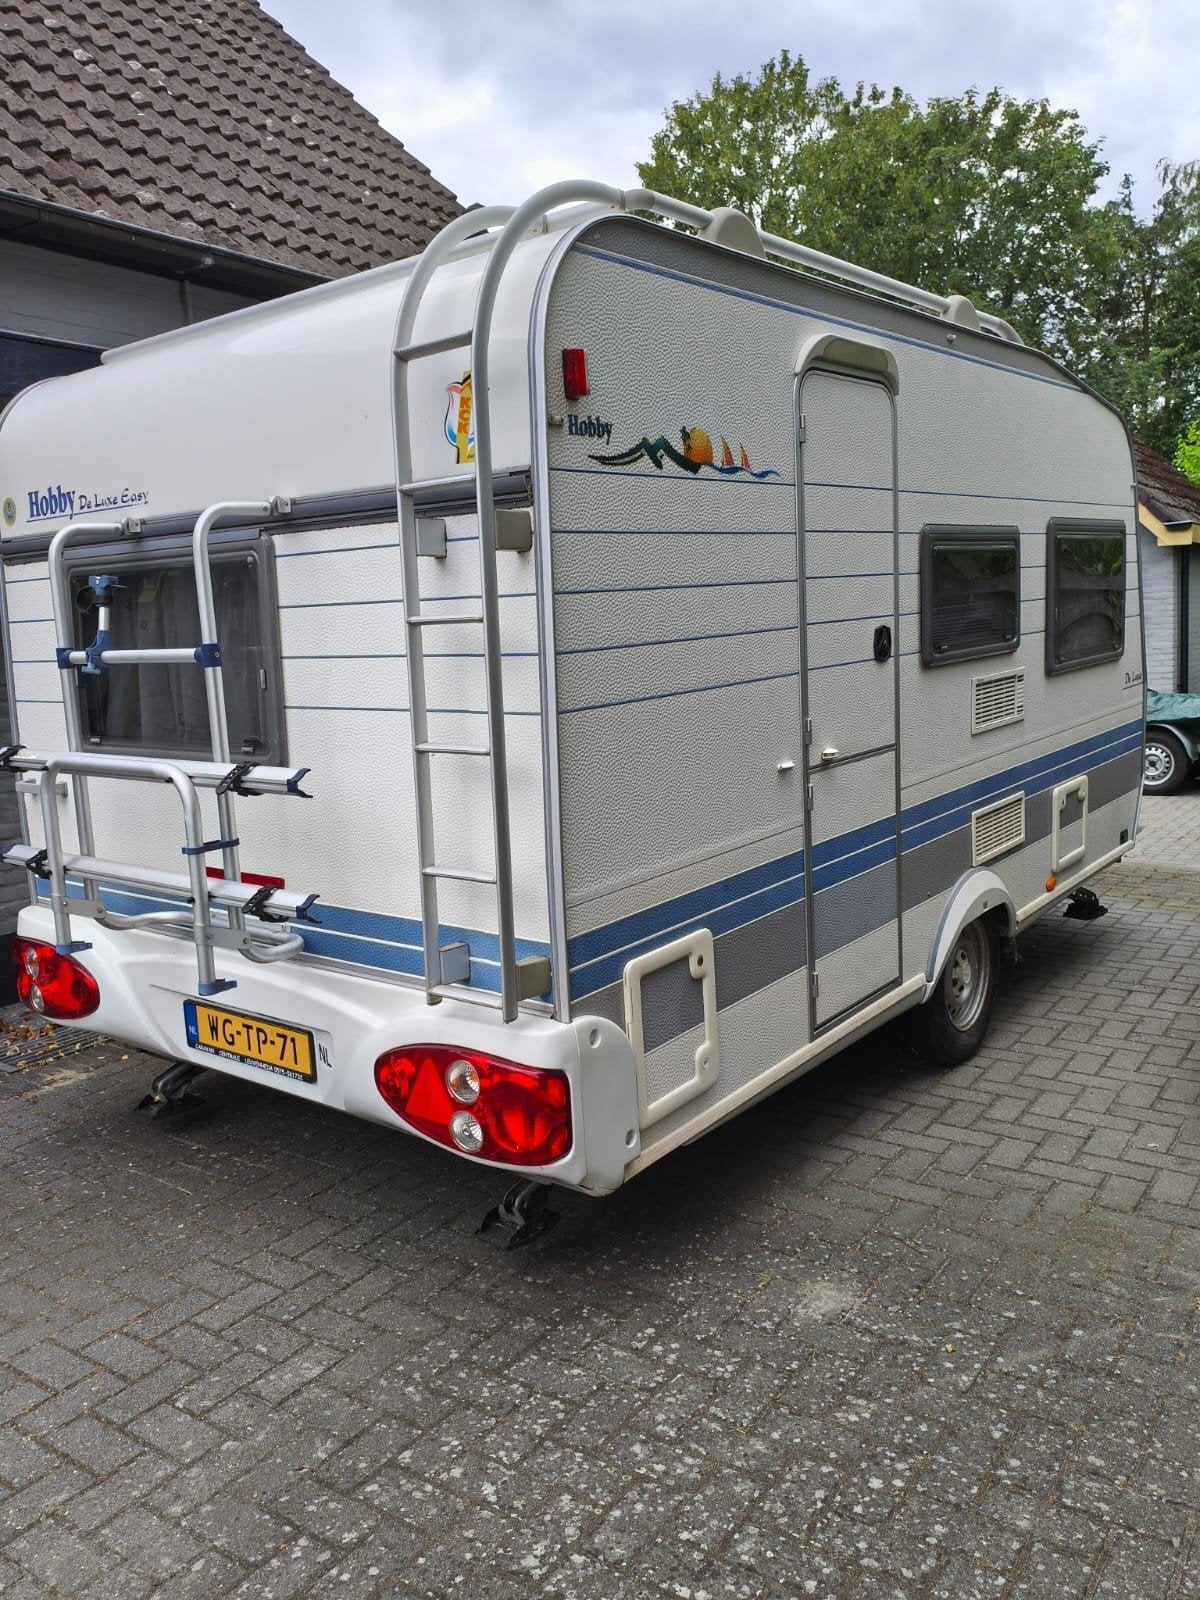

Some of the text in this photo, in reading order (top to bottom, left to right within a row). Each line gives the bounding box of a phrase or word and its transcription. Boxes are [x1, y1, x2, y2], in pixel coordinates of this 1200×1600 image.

[567, 414, 613, 445] Hobby
[27, 484, 76, 520] Hobby
[78, 495, 91, 510] De
[94, 493, 118, 508] Luxe
[120, 487, 149, 505] Easy
[207, 1013, 298, 1065] WG-TP-71
[318, 1042, 333, 1069] NL
